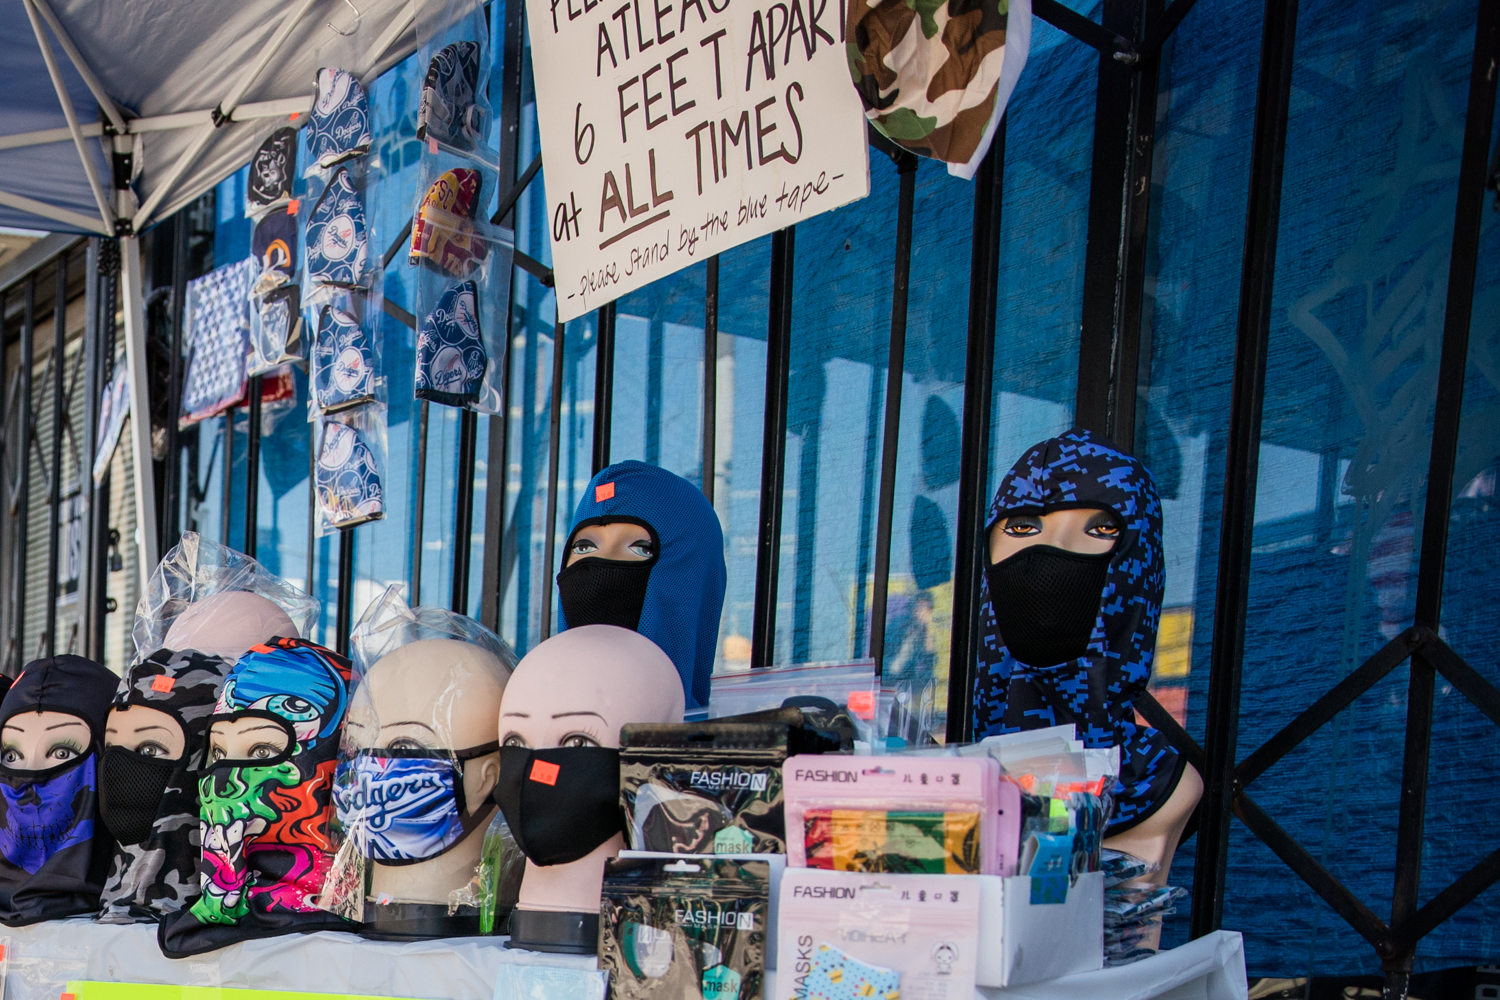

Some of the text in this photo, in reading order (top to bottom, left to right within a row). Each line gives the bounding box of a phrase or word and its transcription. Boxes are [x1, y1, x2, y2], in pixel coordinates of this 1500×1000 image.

[574, 102, 595, 164] 6
[617, 28, 727, 143] FEET
[553, 81, 804, 242] at ALL TIMES
[677, 223, 699, 256] by
[700, 209, 729, 242] the
[737, 193, 767, 226] blue
[690, 771, 767, 791] FASHION
[795, 769, 858, 783] FASHION
[716, 839, 750, 854] mask
[793, 885, 856, 899] FASHION
[674, 909, 754, 930] FASHION
[704, 979, 739, 993] mask
